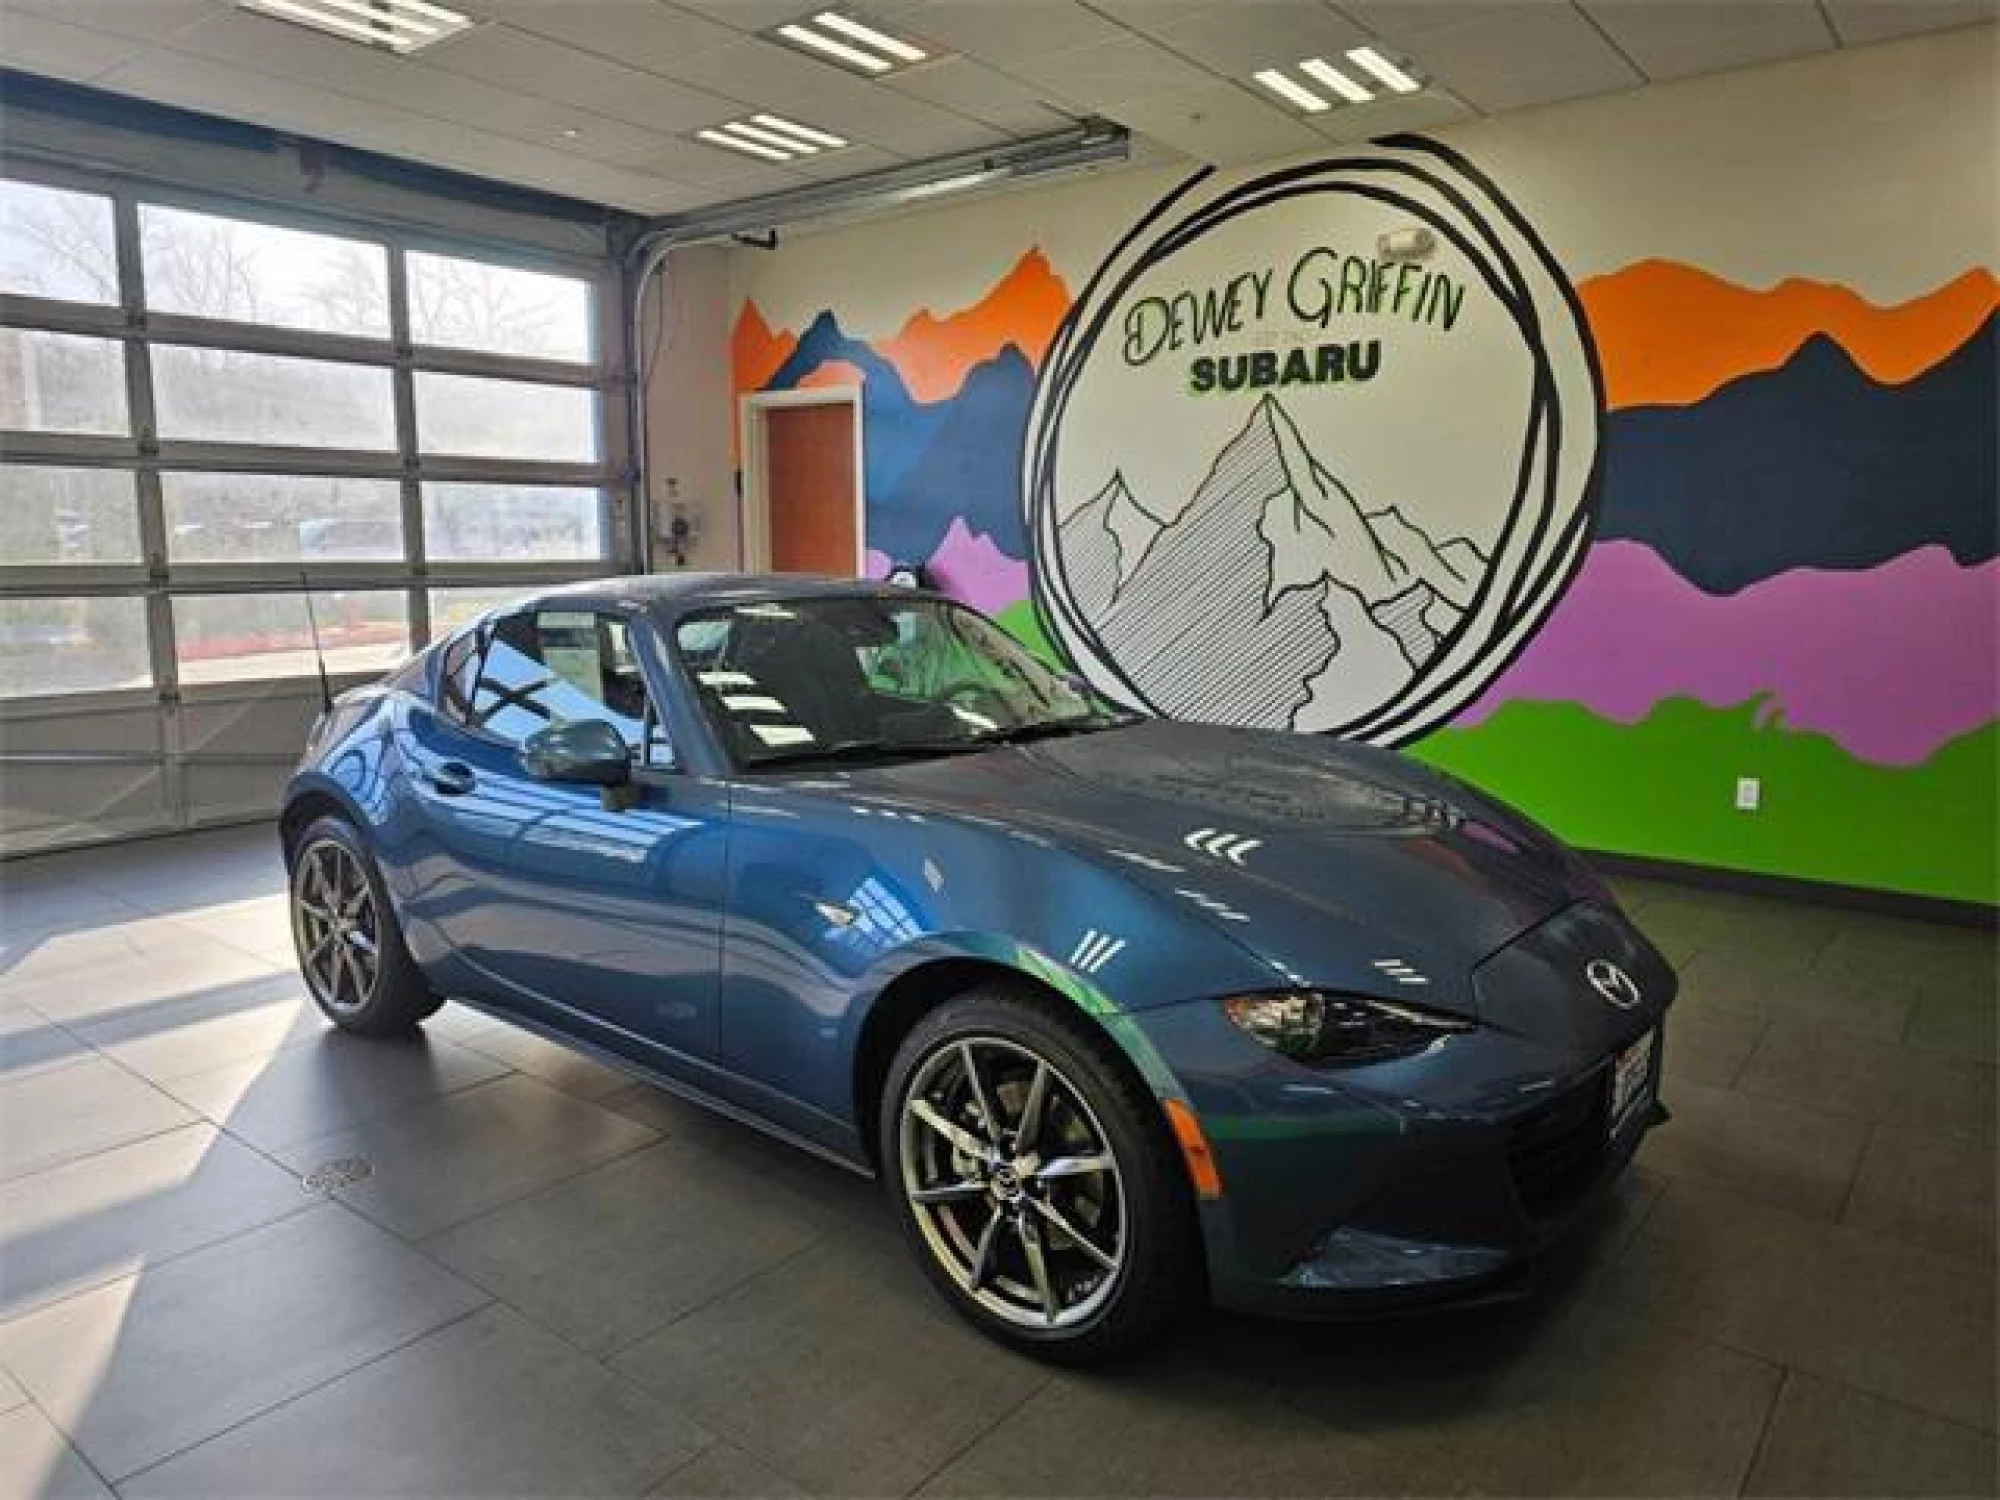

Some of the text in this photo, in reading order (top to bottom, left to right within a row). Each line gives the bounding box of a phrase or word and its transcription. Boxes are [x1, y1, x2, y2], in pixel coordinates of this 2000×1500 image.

[1124, 247, 1464, 366] DEWEY GRIFFIN
[1189, 339, 1382, 391] SUBARU
